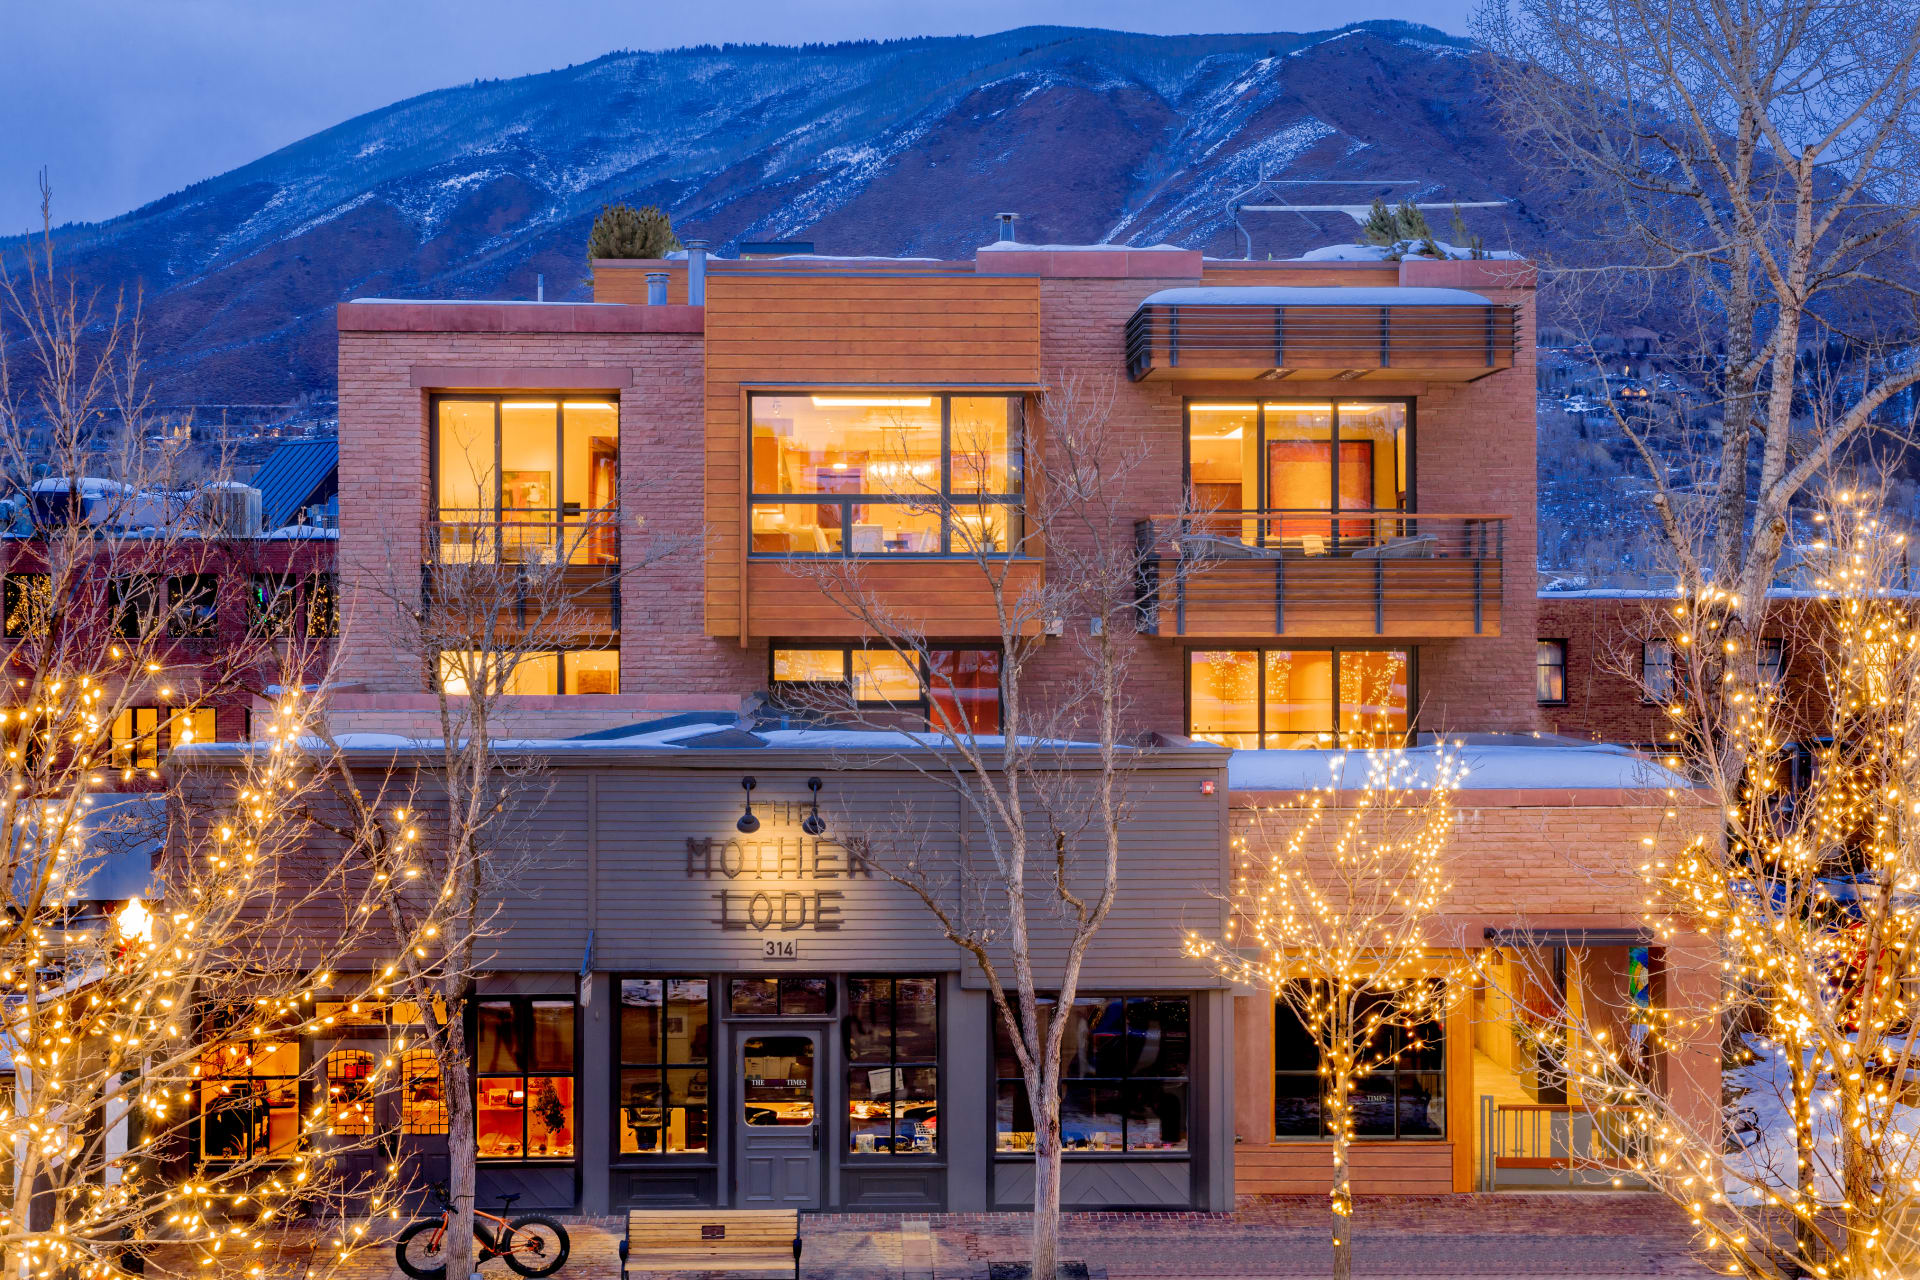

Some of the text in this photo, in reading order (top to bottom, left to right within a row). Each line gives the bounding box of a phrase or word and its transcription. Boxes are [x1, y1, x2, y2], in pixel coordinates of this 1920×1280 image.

[686, 836, 873, 880] MOTHER
[716, 888, 843, 932] LODE
[766, 941, 794, 957] 314
